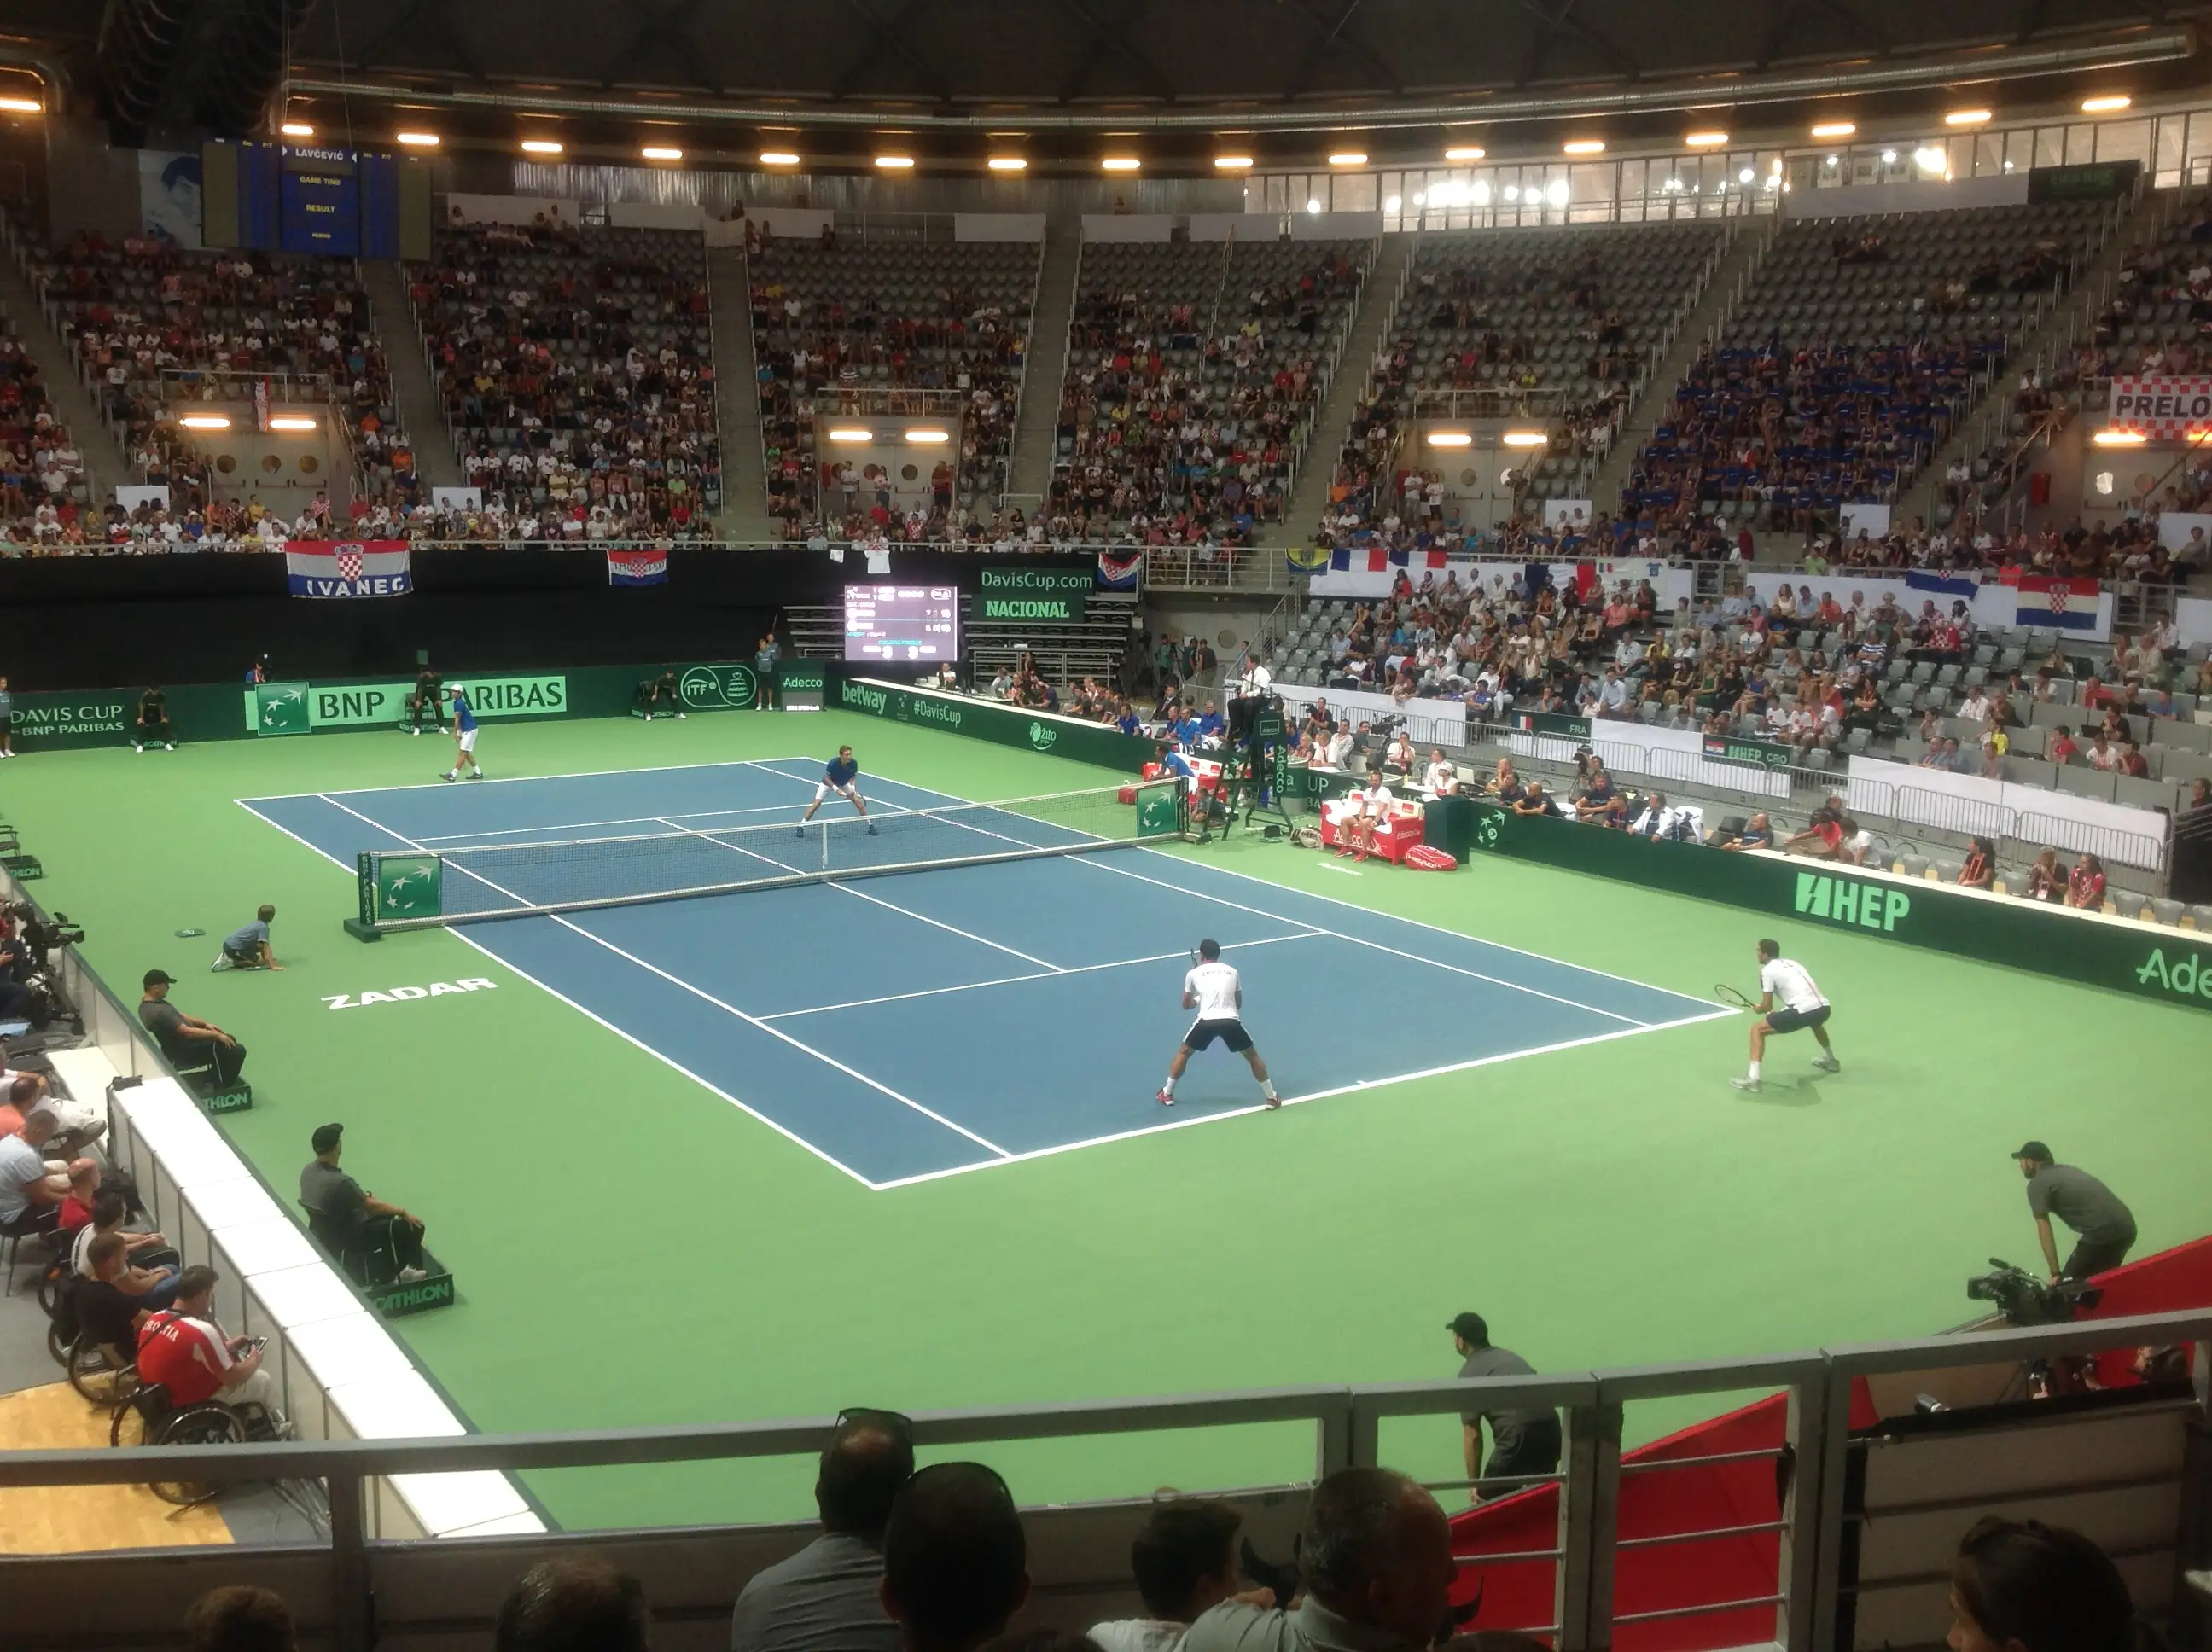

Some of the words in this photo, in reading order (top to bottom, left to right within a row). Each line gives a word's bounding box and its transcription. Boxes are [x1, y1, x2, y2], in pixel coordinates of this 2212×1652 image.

[306, 204, 335, 213] RESULT
[2116, 395, 2211, 418] PRELO
[306, 577, 405, 596] IVANEC
[981, 571, 1092, 590] DavisCup.com
[985, 600, 1070, 619] NACIONAL
[686, 683, 707, 695] ITF
[783, 677, 823, 688] Adecco
[318, 691, 385, 719] BNP
[842, 681, 887, 715] betway
[10, 707, 73, 724] DAVIS
[78, 705, 123, 720] CUP
[913, 699, 961, 728] #DavisCup
[21, 725, 55, 736] BNP
[59, 722, 125, 734] PARIBAS
[1570, 724, 1587, 735] FRA
[1767, 753, 1787, 765] CRO
[1277, 745, 1287, 794] Adecco
[1832, 880, 1911, 932] HEP
[2135, 948, 2212, 998] Ade
[320, 977, 500, 1010] ZADAR
